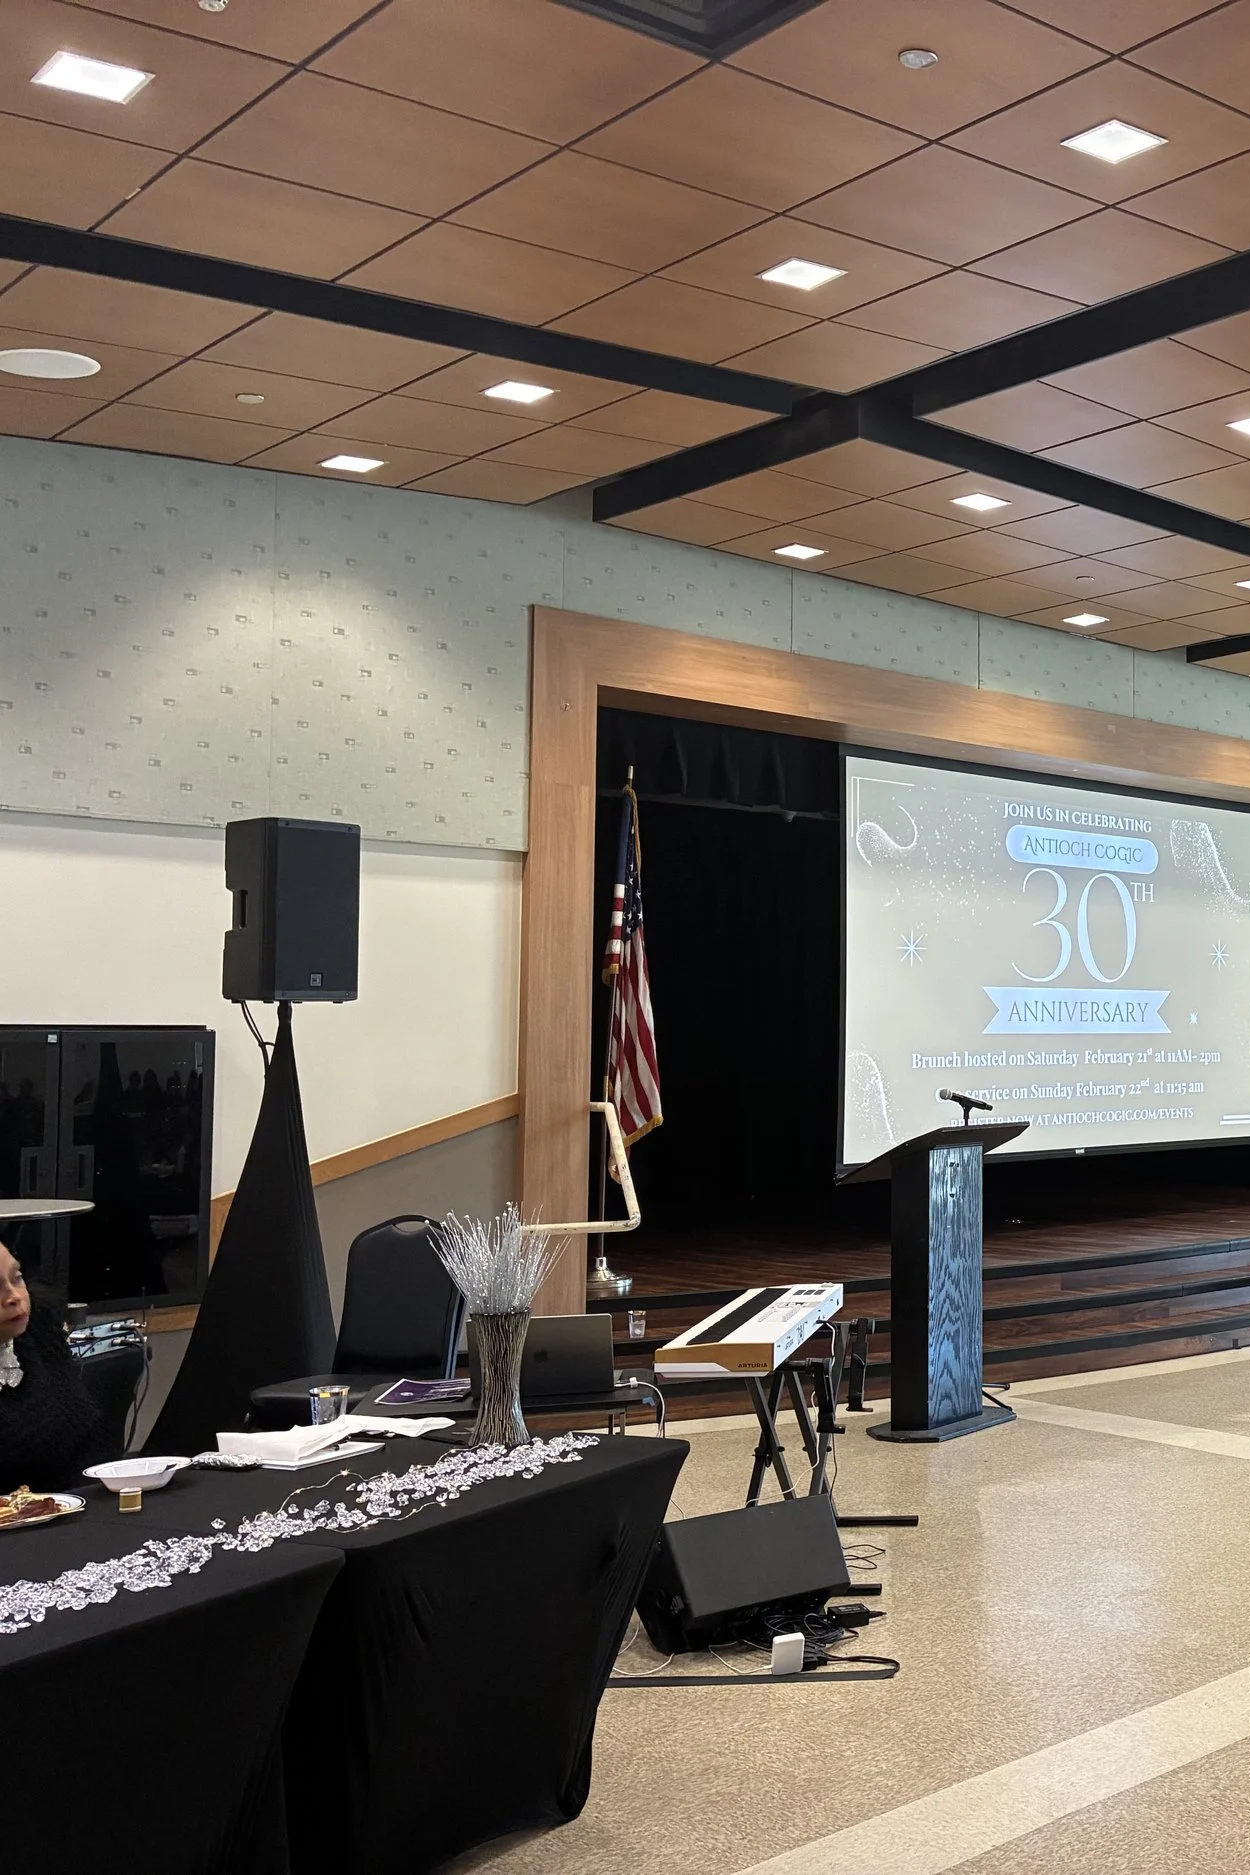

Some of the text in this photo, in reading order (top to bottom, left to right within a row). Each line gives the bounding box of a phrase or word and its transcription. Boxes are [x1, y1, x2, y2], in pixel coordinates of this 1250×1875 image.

[1003, 802, 1152, 833] JOIN US IN CELEBRATING
[1024, 835, 1144, 864] ANTIOCH COGIC
[1007, 1000, 1149, 1023] ANNIVERSARY
[911, 1051, 961, 1069] Brunch
[964, 1050, 1007, 1067] hosted
[1008, 1054, 1025, 1066] on
[1027, 1049, 1079, 1068] Saturday
[1084, 1048, 1134, 1066] February
[1154, 1050, 1165, 1063] at
[1199, 1051, 1221, 1065] 2pm
[1012, 1086, 1029, 1099] on
[1030, 1082, 1074, 1100] Sunday
[1076, 1081, 1127, 1098] February
[1153, 1081, 1164, 1094] at
[1166, 1081, 1187, 1096] 11:15
[1188, 1082, 1204, 1093] am
[1036, 1114, 1050, 1126] AT
[1051, 1107, 1194, 1125] ANTIOCHCOGIC.COM/EVENTS
